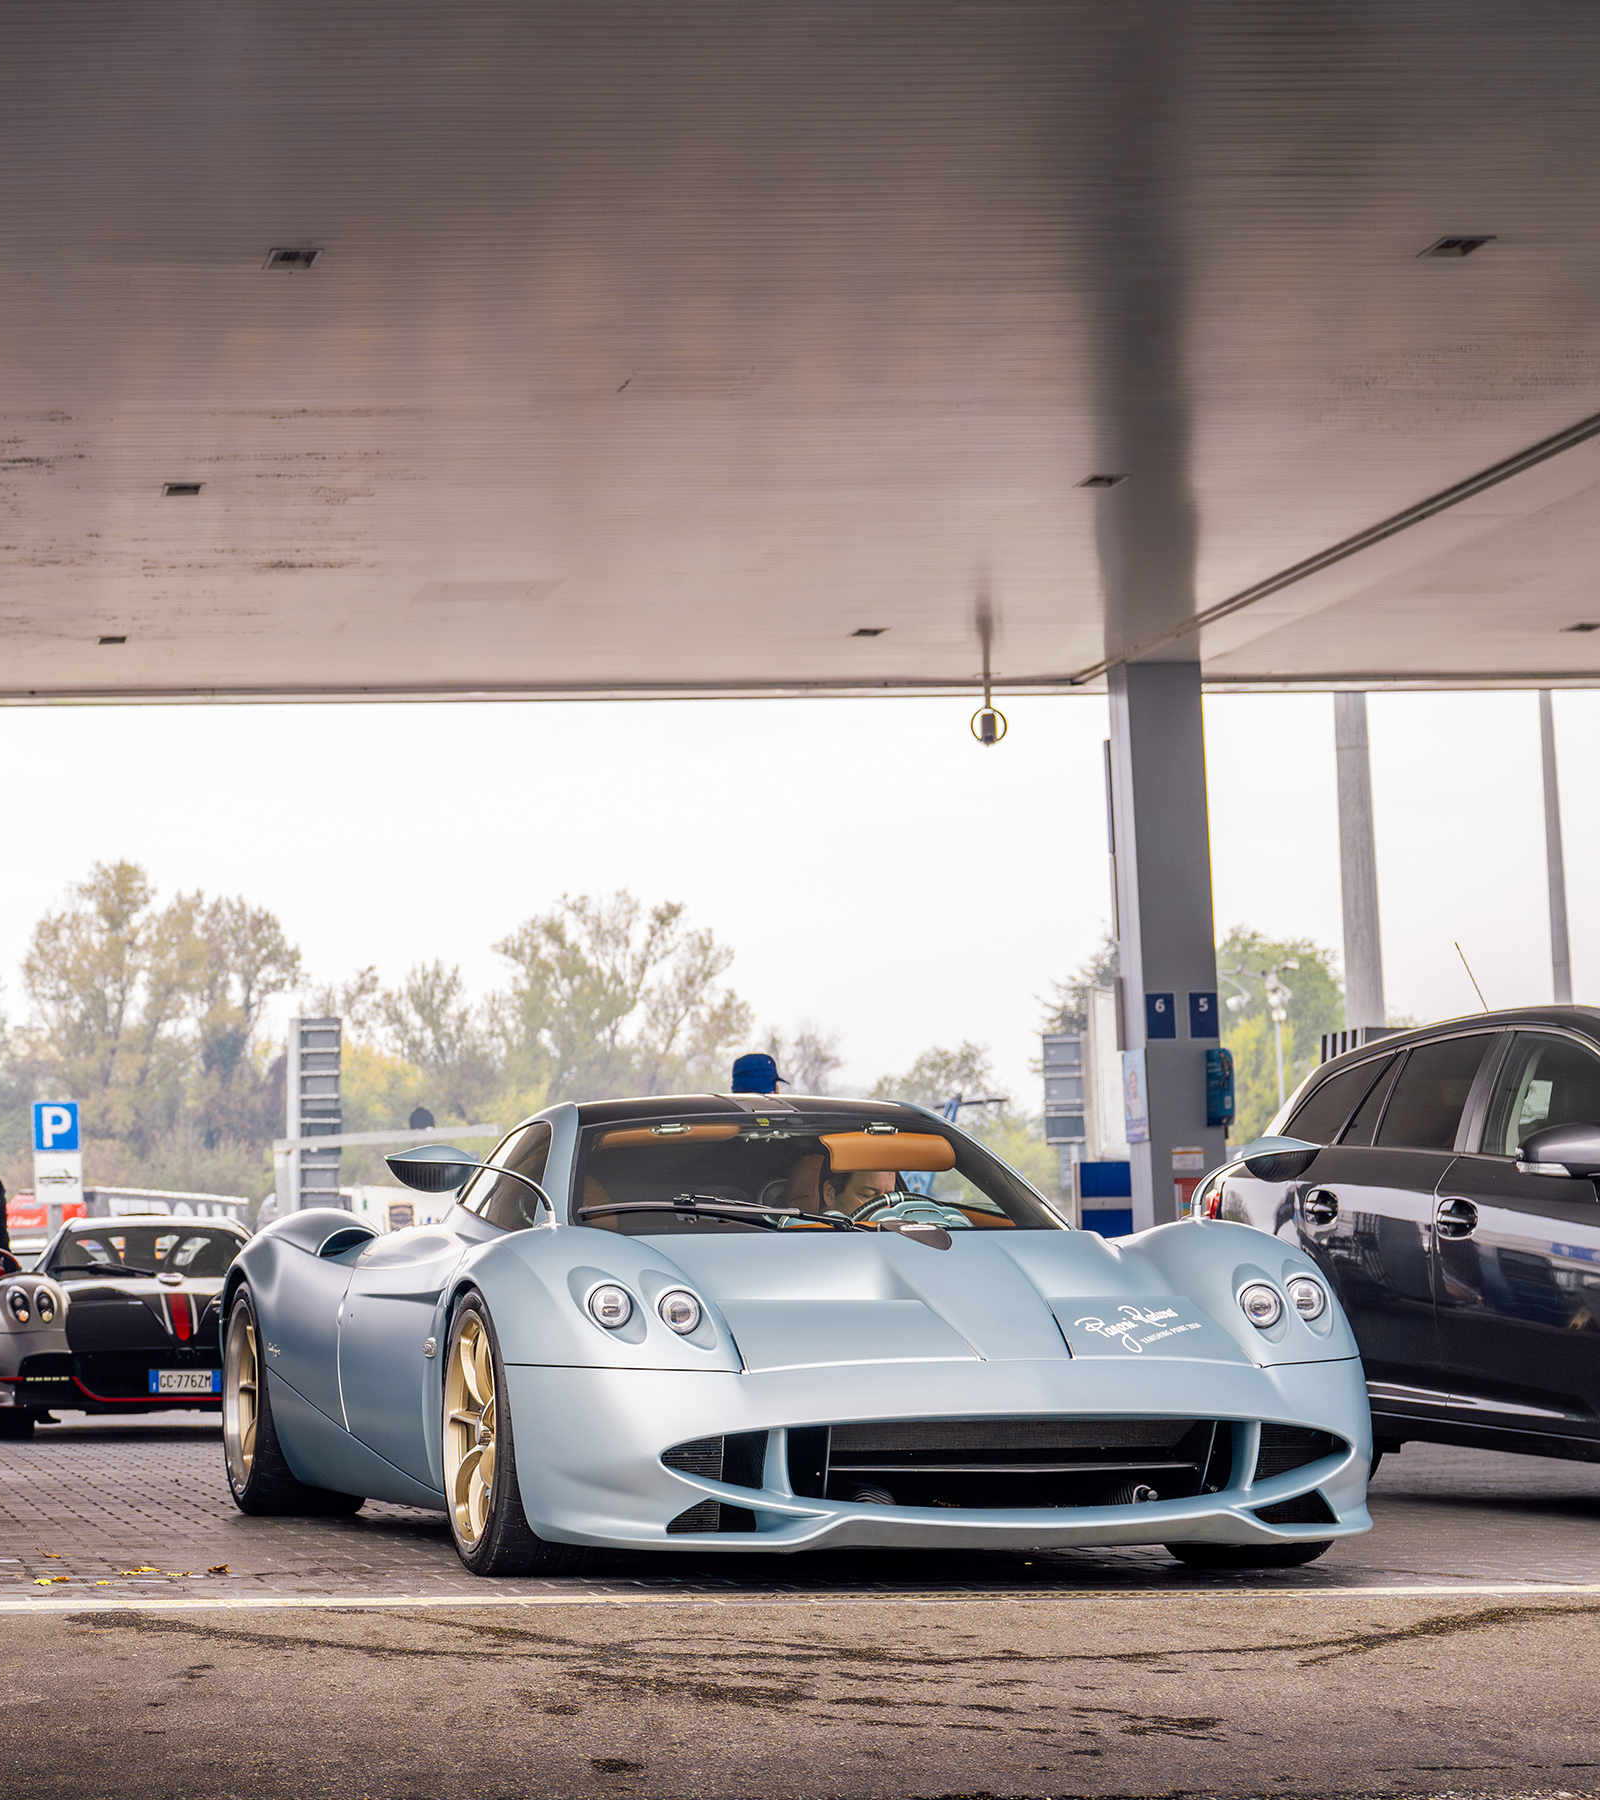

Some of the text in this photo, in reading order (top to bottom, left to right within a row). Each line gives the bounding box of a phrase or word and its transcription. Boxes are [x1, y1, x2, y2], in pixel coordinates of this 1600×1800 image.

[1155, 999, 1165, 1012] 6
[1199, 998, 1208, 1011] 5
[41, 1106, 72, 1148] P
